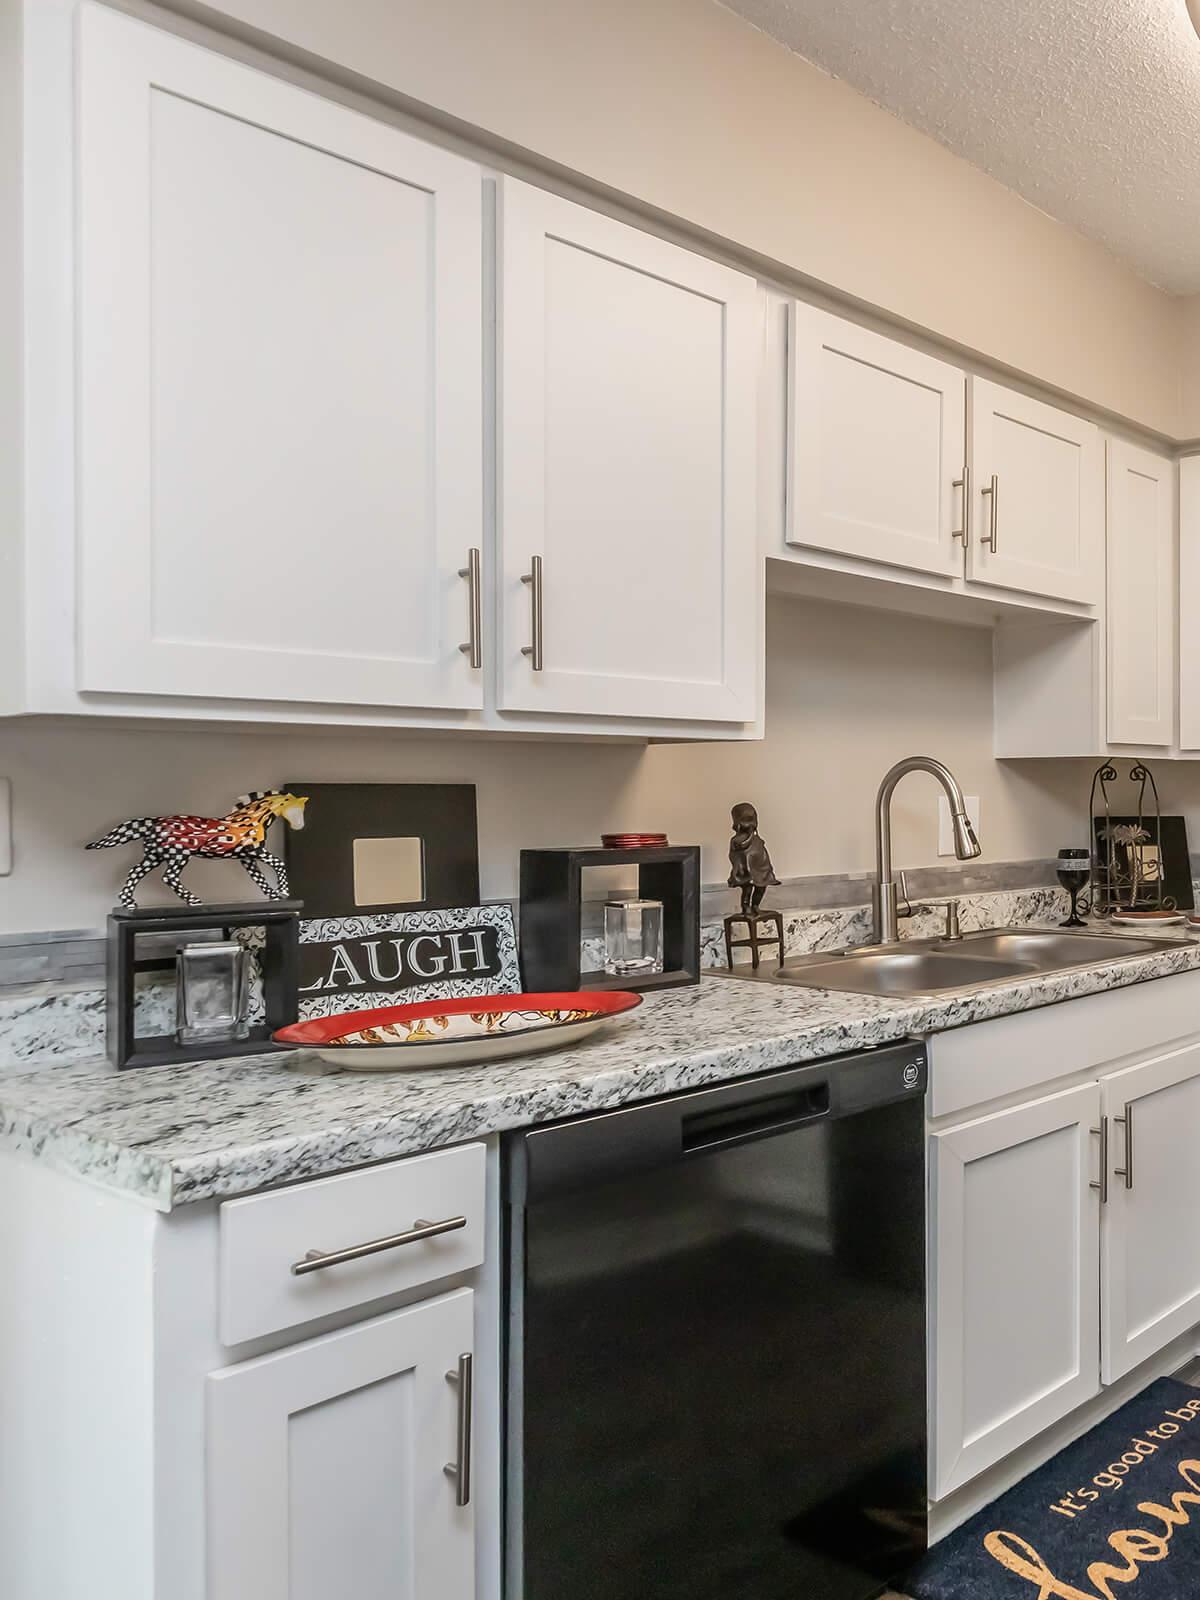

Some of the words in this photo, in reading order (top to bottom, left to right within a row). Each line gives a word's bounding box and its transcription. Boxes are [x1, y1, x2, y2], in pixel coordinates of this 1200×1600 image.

[1049, 1487, 1100, 1519] It's
[1092, 1438, 1160, 1490] good
[1145, 1421, 1180, 1440] to
